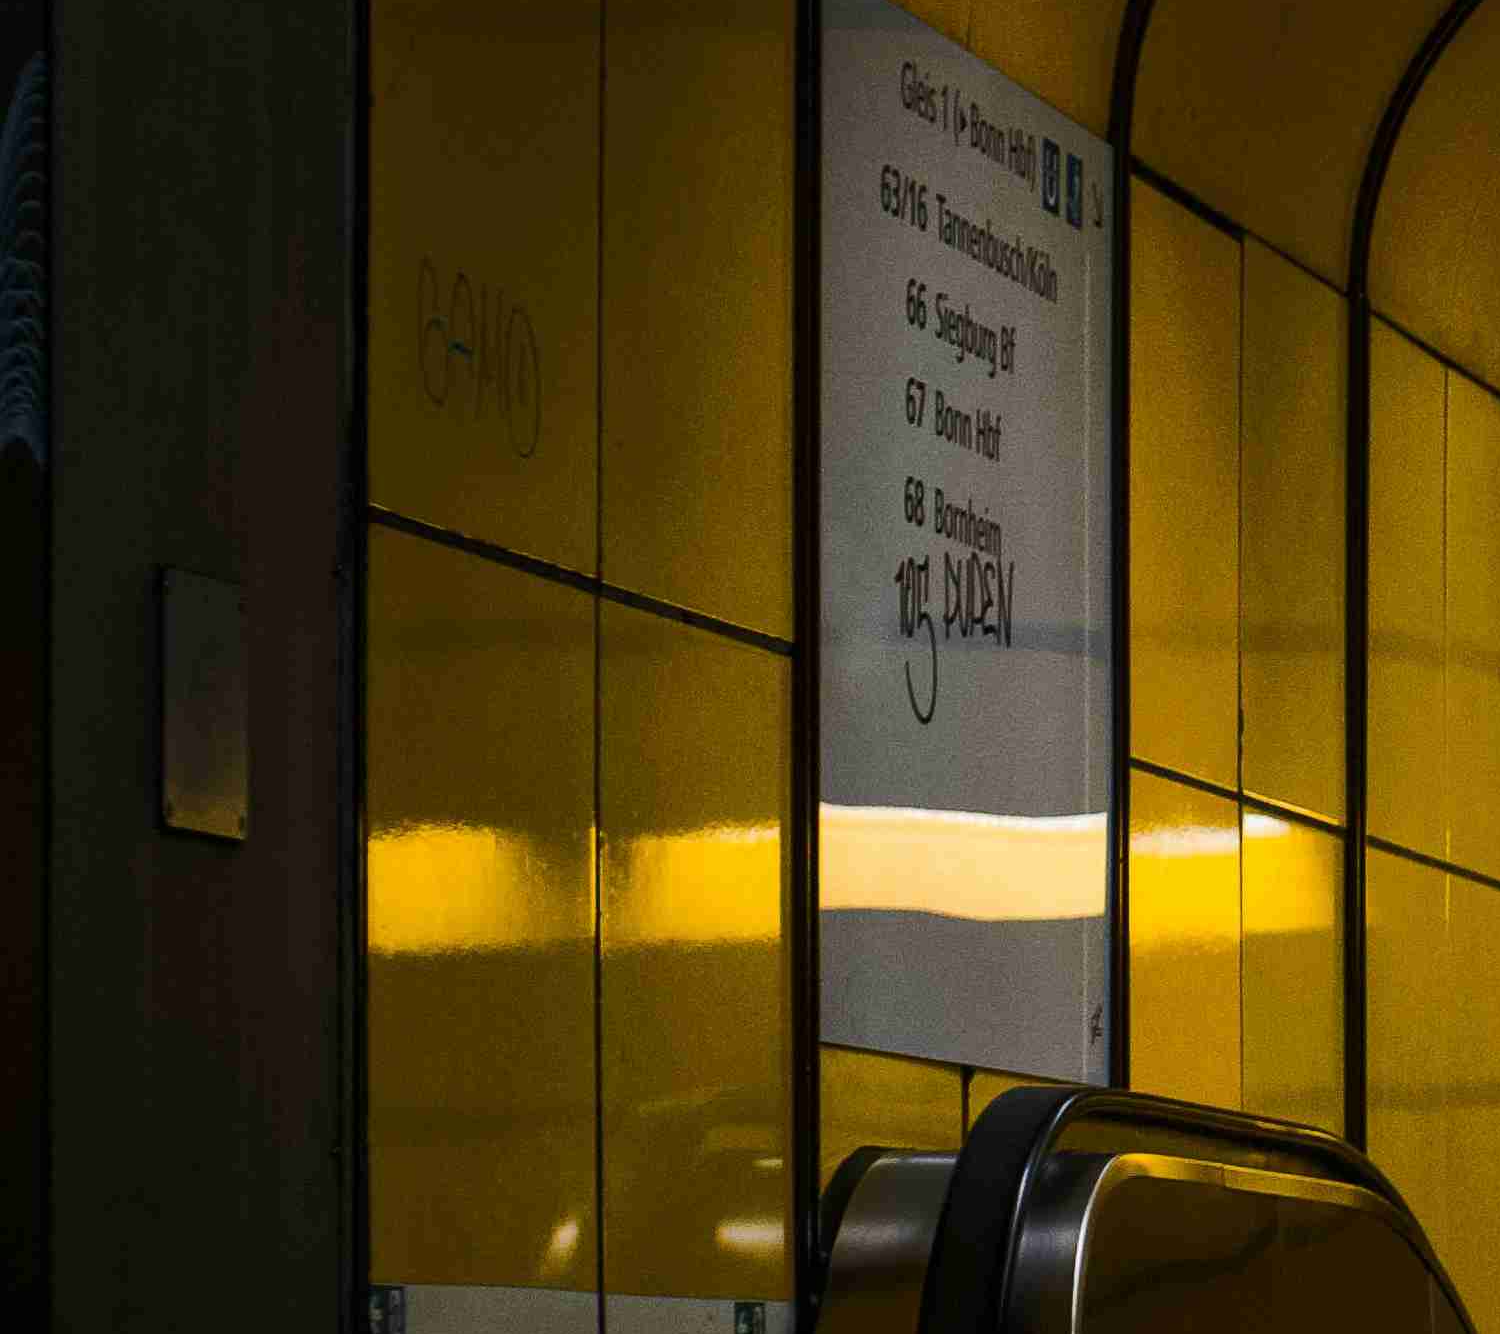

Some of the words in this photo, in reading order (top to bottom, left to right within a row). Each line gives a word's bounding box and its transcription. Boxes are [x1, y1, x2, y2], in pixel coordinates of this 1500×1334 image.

[902, 62, 937, 124] Gleis
[880, 163, 929, 233] 63/16
[935, 192, 1057, 305] Tannenbusch/Köln
[906, 277, 927, 331] 66
[934, 292, 997, 379] Siegburg
[1000, 325, 1016, 374] Bf
[906, 377, 926, 428] 67
[935, 389, 973, 450] Bonn
[975, 408, 1001, 463] Hbf
[904, 475, 925, 528] 68
[934, 487, 1002, 557] Bornheim
